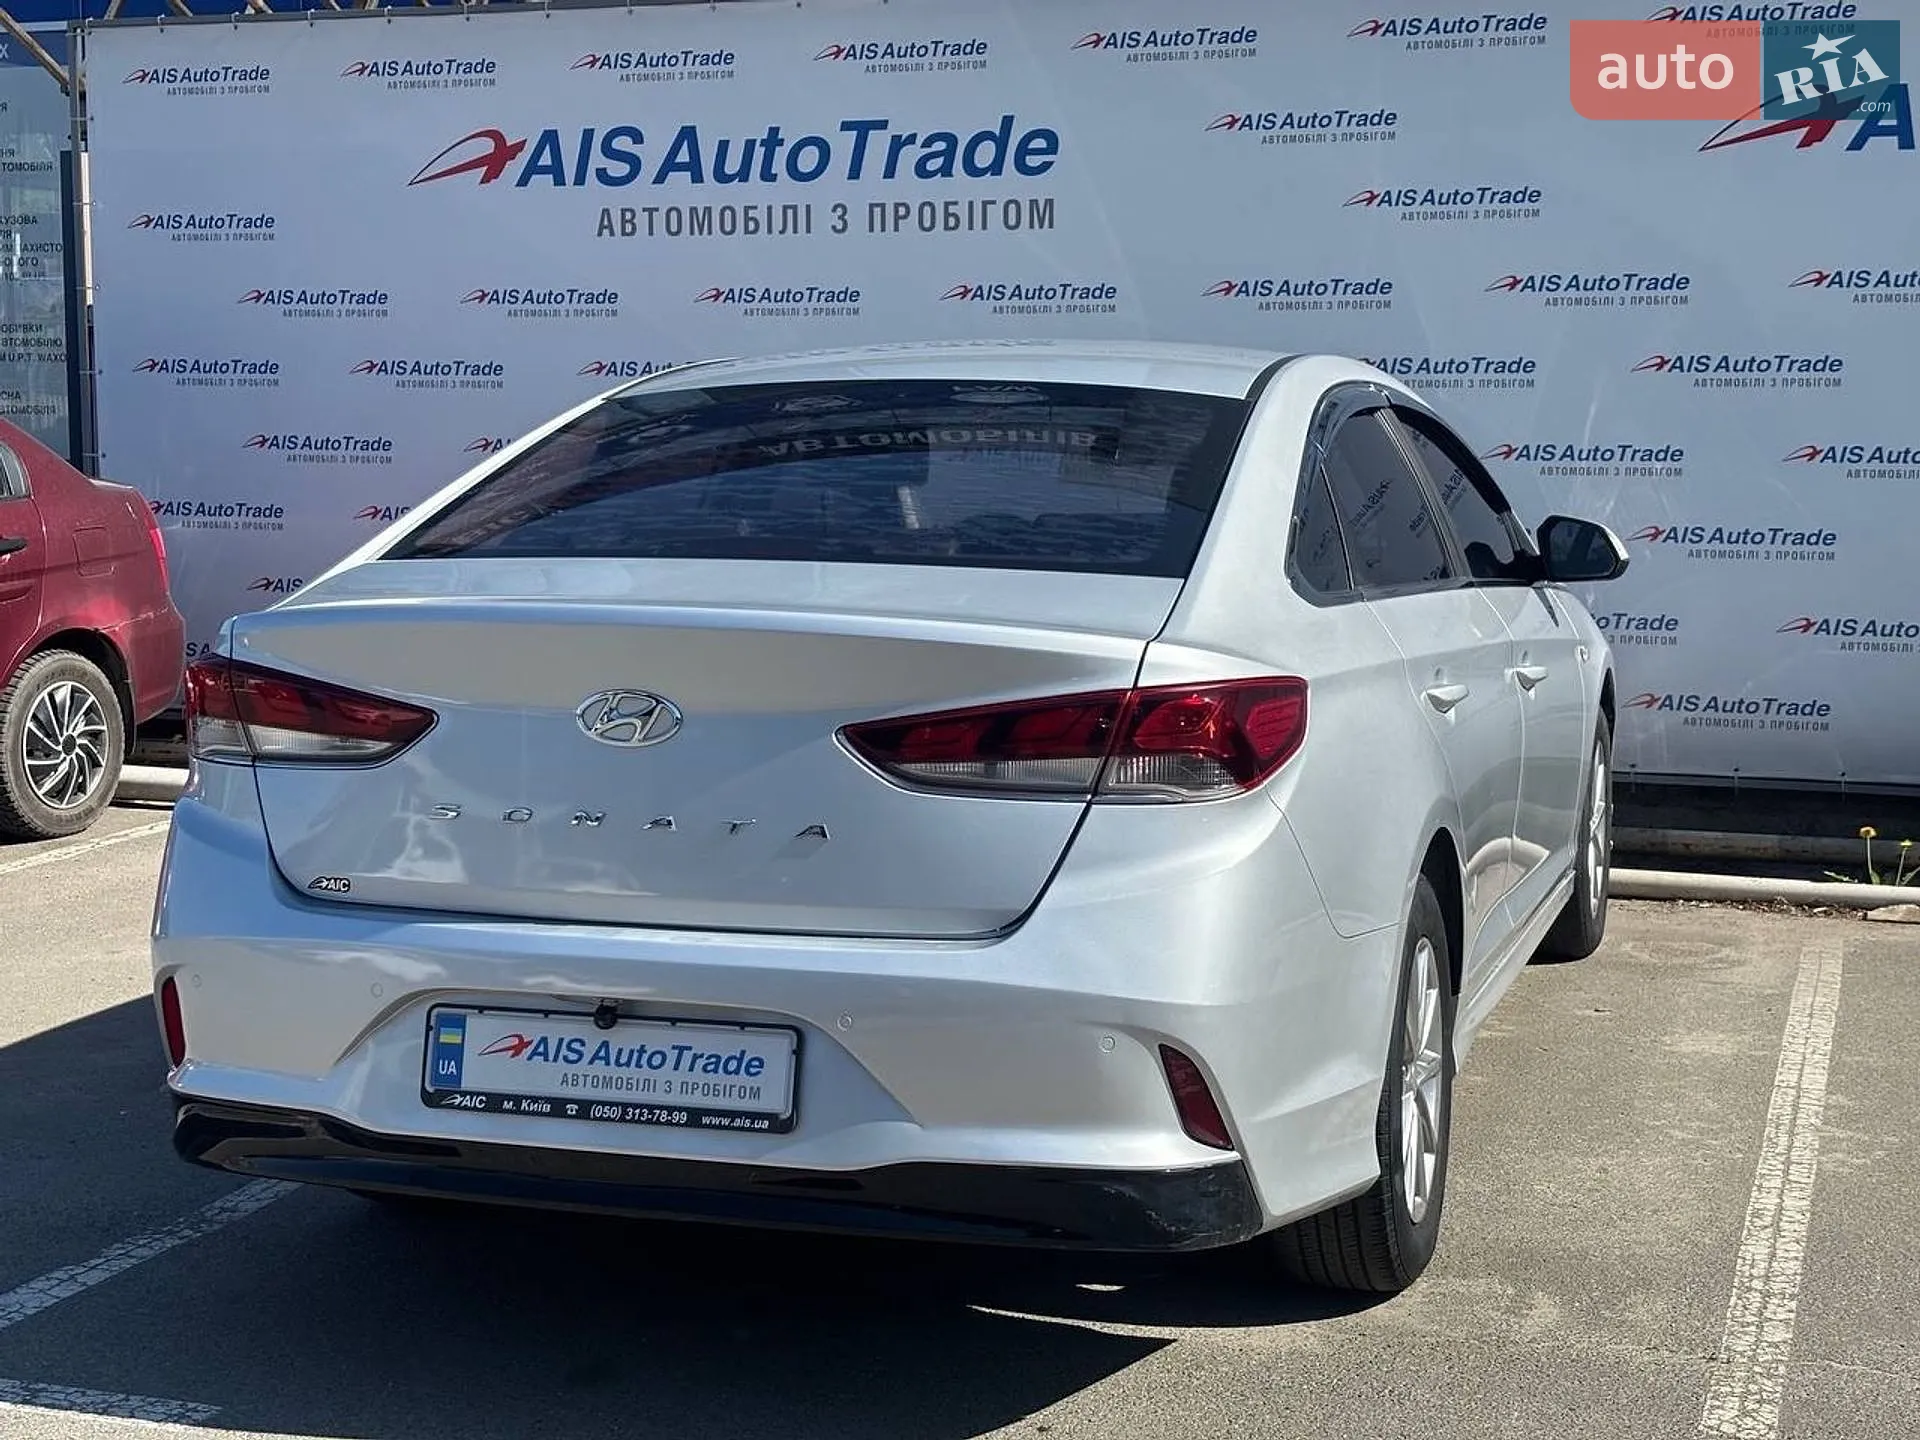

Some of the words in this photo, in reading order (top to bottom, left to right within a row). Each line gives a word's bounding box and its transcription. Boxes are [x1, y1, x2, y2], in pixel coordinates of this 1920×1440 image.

[1725, 2, 1857, 21] AutoTrade
[1381, 18, 1422, 37] AIS
[1424, 13, 1547, 34] AutoTrade
[1103, 31, 1141, 49] AIS
[1143, 26, 1257, 47] AutoTrade
[1405, 40, 1473, 51] АВТОМОБІЛІ
[1488, 35, 1546, 47] ПРОБІГОМ
[843, 44, 878, 61] AIS
[880, 39, 987, 59] AutoTrade
[1126, 52, 1189, 63] АВТОМОБІЛІ
[1203, 48, 1256, 60] ПРОБІГОМ
[368, 61, 399, 76] AIS
[401, 59, 496, 75] AutoTrade
[600, 53, 632, 69] AIS
[634, 50, 735, 68] AutoTrade
[864, 62, 924, 73] АВТОМОБІЛІ
[937, 60, 986, 71] ПРОБІГОМ
[149, 69, 178, 83] AIS
[180, 66, 270, 83] AutoTrade
[619, 73, 675, 82] АВТОМОБІЛІ
[687, 71, 734, 80] ПРОБІГОМ
[167, 86, 217, 96] АВТОМОБІЛІ
[228, 85, 269, 94] ПРОБІГОМ
[387, 79, 441, 89] АВТОМОБІЛІ
[451, 78, 495, 87] ПРОБІГОМ
[1238, 113, 1276, 131] AIS
[1279, 110, 1397, 129] AutoTrade
[1261, 134, 1326, 145] АВТОМОБІЛІ
[1341, 131, 1396, 142] ПРОБІГОМ
[515, 126, 645, 187] AIS
[652, 116, 1060, 185] AutoTrade
[1377, 190, 1417, 207] AIS
[1420, 187, 1541, 206] AutoTrade
[153, 215, 182, 230] AIS
[184, 214, 275, 230] AutoTrade
[597, 203, 813, 237] АВТОМОБІЛІ
[830, 201, 849, 234] З
[868, 198, 1056, 232] ПРОБІГОМ
[1400, 210, 1469, 221] АВТОМОБІЛІ
[1483, 208, 1540, 219] ПРОБІГОМ
[1234, 280, 1274, 297] AIS
[1276, 278, 1393, 297] AutoTrade
[1520, 275, 1562, 293] AIS
[1564, 273, 1690, 292] AutoTrade
[1827, 270, 1871, 288] AIS
[264, 290, 294, 305] AIS
[296, 290, 388, 305] AutoTrade
[487, 290, 520, 305] AIS
[521, 289, 618, 305] AutoTrade
[723, 288, 758, 303] AIS
[760, 287, 861, 303] AutoTrade
[971, 285, 1007, 301] AIS
[1008, 283, 1117, 301] AutoTrade
[992, 305, 1052, 315] АВТОМОБІЛІ
[1065, 304, 1116, 314] ПРОБІГОМ
[1257, 301, 1322, 311] АВТОМОБІЛІ
[1336, 300, 1392, 310] ПРОБІГОМ
[1544, 296, 1614, 307] АВТОМОБІЛІ
[1629, 295, 1689, 306] ПРОБІГОМ
[282, 309, 332, 318] АВТОМОБІЛІ
[345, 309, 388, 318] ПРОБІГОМ
[507, 309, 560, 318] АВТОМОБІЛІ
[573, 309, 618, 318] ПРОБІГОМ
[743, 308, 800, 317] АВТОМОБІЛІ
[812, 307, 860, 316] ПРОБІГОМ
[158, 360, 188, 374] AIS
[190, 359, 280, 375] AutoTrade
[377, 360, 408, 375] AIS
[409, 360, 504, 376] AutoTrade
[605, 361, 638, 376] AIS
[1415, 356, 1536, 374] AutoTrade
[1669, 356, 1711, 373] AIS
[1712, 355, 1843, 373] AutoTrade
[395, 380, 449, 389] АВТОМОБІЛІ
[460, 380, 504, 389] ПРОБІГОМ
[1479, 379, 1535, 389] ПРОБІГОМ
[1693, 377, 1764, 388] АВТОМОБІЛІ
[1781, 376, 1842, 388] ПРОБІГОМ
[268, 435, 298, 450] AIS
[299, 435, 393, 452] AutoTrade
[1516, 444, 1557, 461] AIS
[1559, 445, 1684, 462] AutoTrade
[1820, 446, 1864, 464] AIS
[1539, 466, 1610, 477] АВТОМОБІЛІ
[1624, 466, 1684, 477] ПРОБІГОМ
[164, 500, 192, 516] AIS
[194, 501, 284, 519] AutoTrade
[1662, 527, 1705, 545] AIS
[1707, 527, 1837, 547] AutoTrade
[1688, 549, 1760, 560] АВТОМОБІЛІ
[1775, 550, 1836, 561] ПРОБІГОМ
[1814, 618, 1859, 636] AIS
[1659, 694, 1700, 712] AIS
[1703, 696, 1831, 717] AutoTrade
[1683, 717, 1754, 729] АВТОМОБІЛІ
[1769, 720, 1830, 732] ПРОБІГОМ
[430, 803, 830, 841] SONATA
[527, 1036, 588, 1064] AIS
[589, 1042, 765, 1077] AutoTrade
[440, 1060, 457, 1077] UA
[560, 1072, 657, 1093] АВТОМОБІЛІ
[680, 1080, 762, 1100] ПРОБІГОМ
[521, 1100, 552, 1113] Київ
[590, 1104, 622, 1120] (050)
[625, 1107, 688, 1124] 313-78-99
[701, 1114, 770, 1129] www.ais.ua
